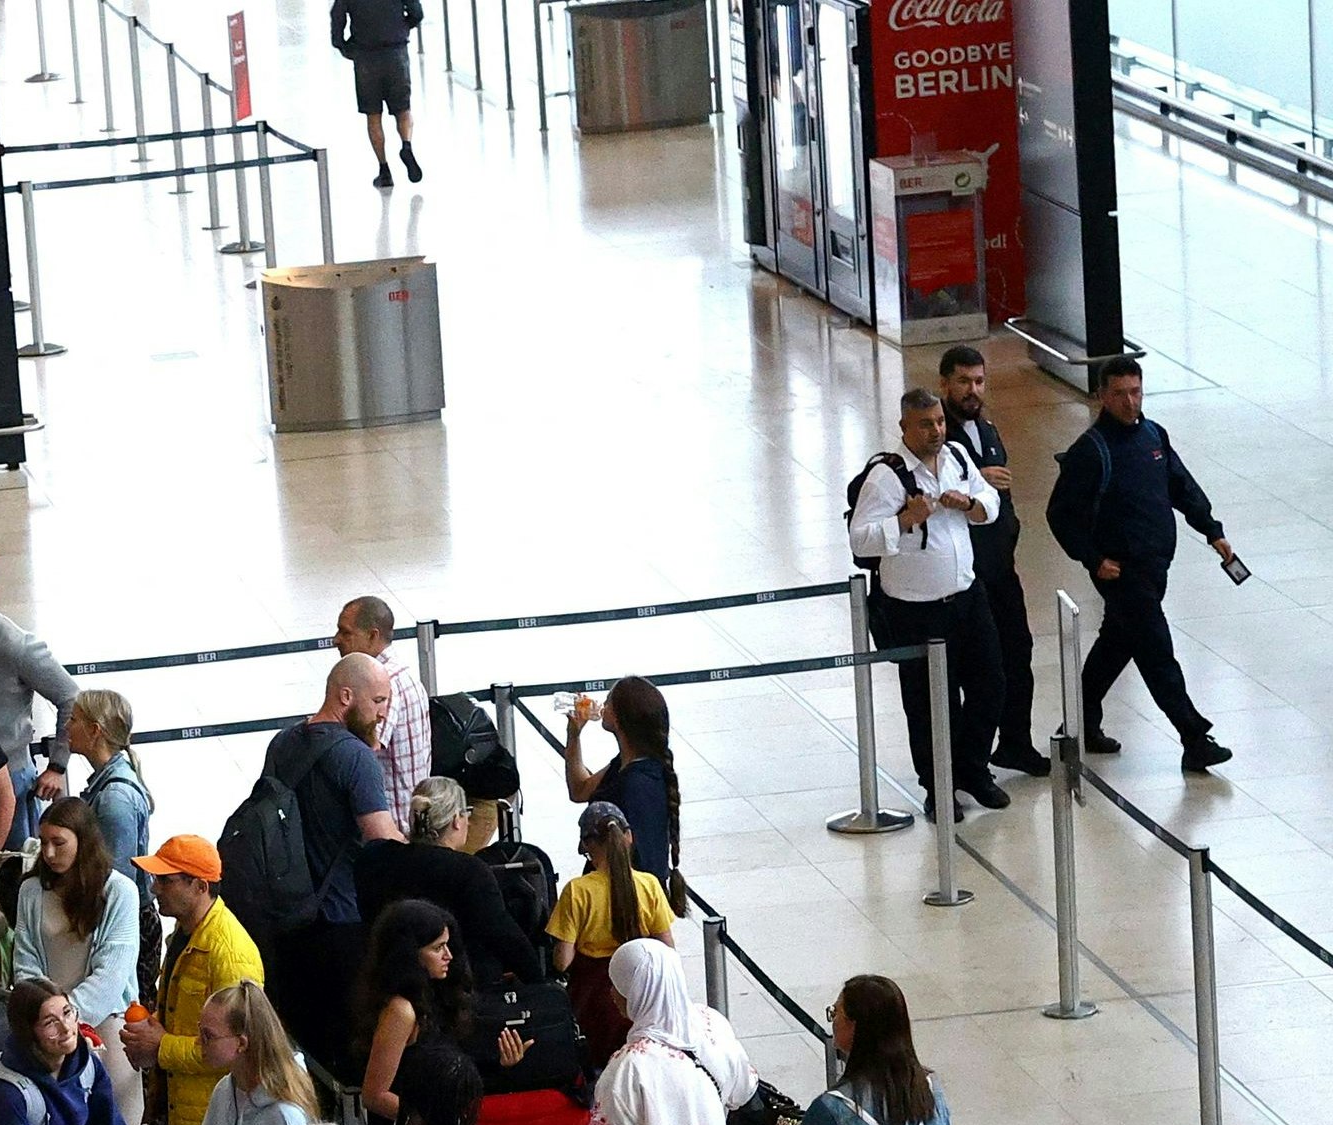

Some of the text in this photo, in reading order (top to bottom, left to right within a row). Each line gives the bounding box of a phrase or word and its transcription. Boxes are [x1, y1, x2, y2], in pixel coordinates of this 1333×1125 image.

[894, 42, 1012, 69] GOODBYE
[895, 64, 1013, 99] BERLIN
[757, 591, 776, 602] BER
[637, 605, 656, 617] BER
[517, 617, 537, 628] BER
[197, 652, 217, 663] BER
[834, 655, 854, 666] BER
[77, 663, 96, 674] BER
[710, 668, 730, 680] BER
[585, 680, 605, 691] BER
[181, 727, 202, 738] BER
